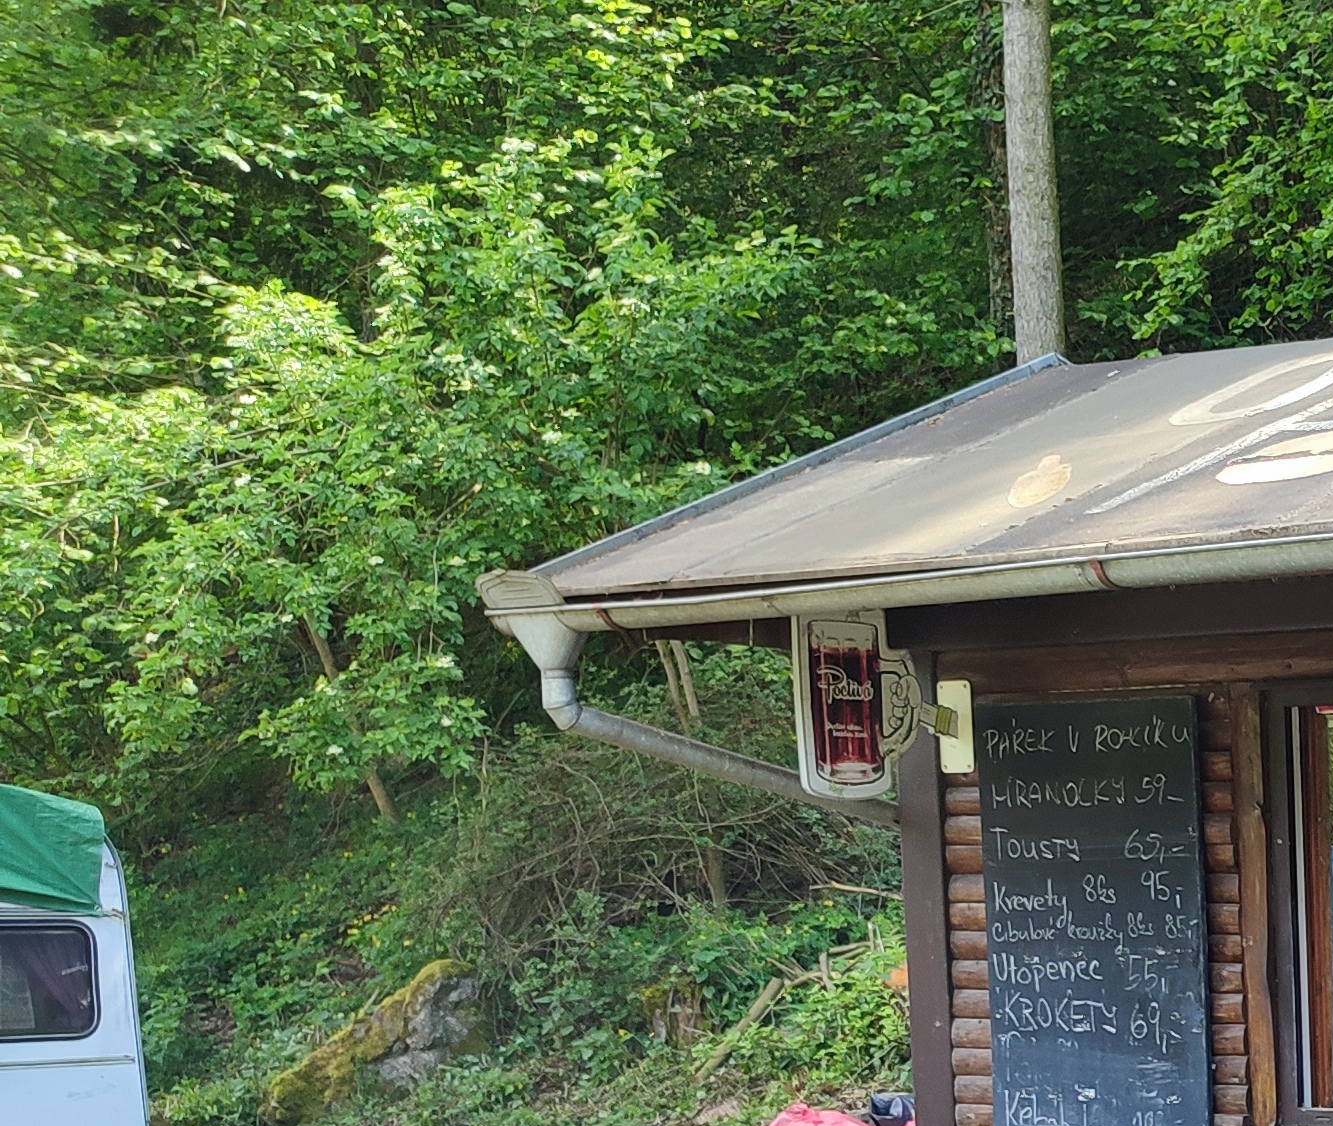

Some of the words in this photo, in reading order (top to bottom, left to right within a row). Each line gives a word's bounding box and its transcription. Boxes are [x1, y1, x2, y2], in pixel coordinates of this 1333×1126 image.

[816, 665, 874, 705] Poctivá
[1068, 725, 1079, 753] V
[991, 775, 1126, 810] HRANOLKY
[993, 878, 1068, 922] Krevety
[1004, 991, 1118, 1034] KROKETY
